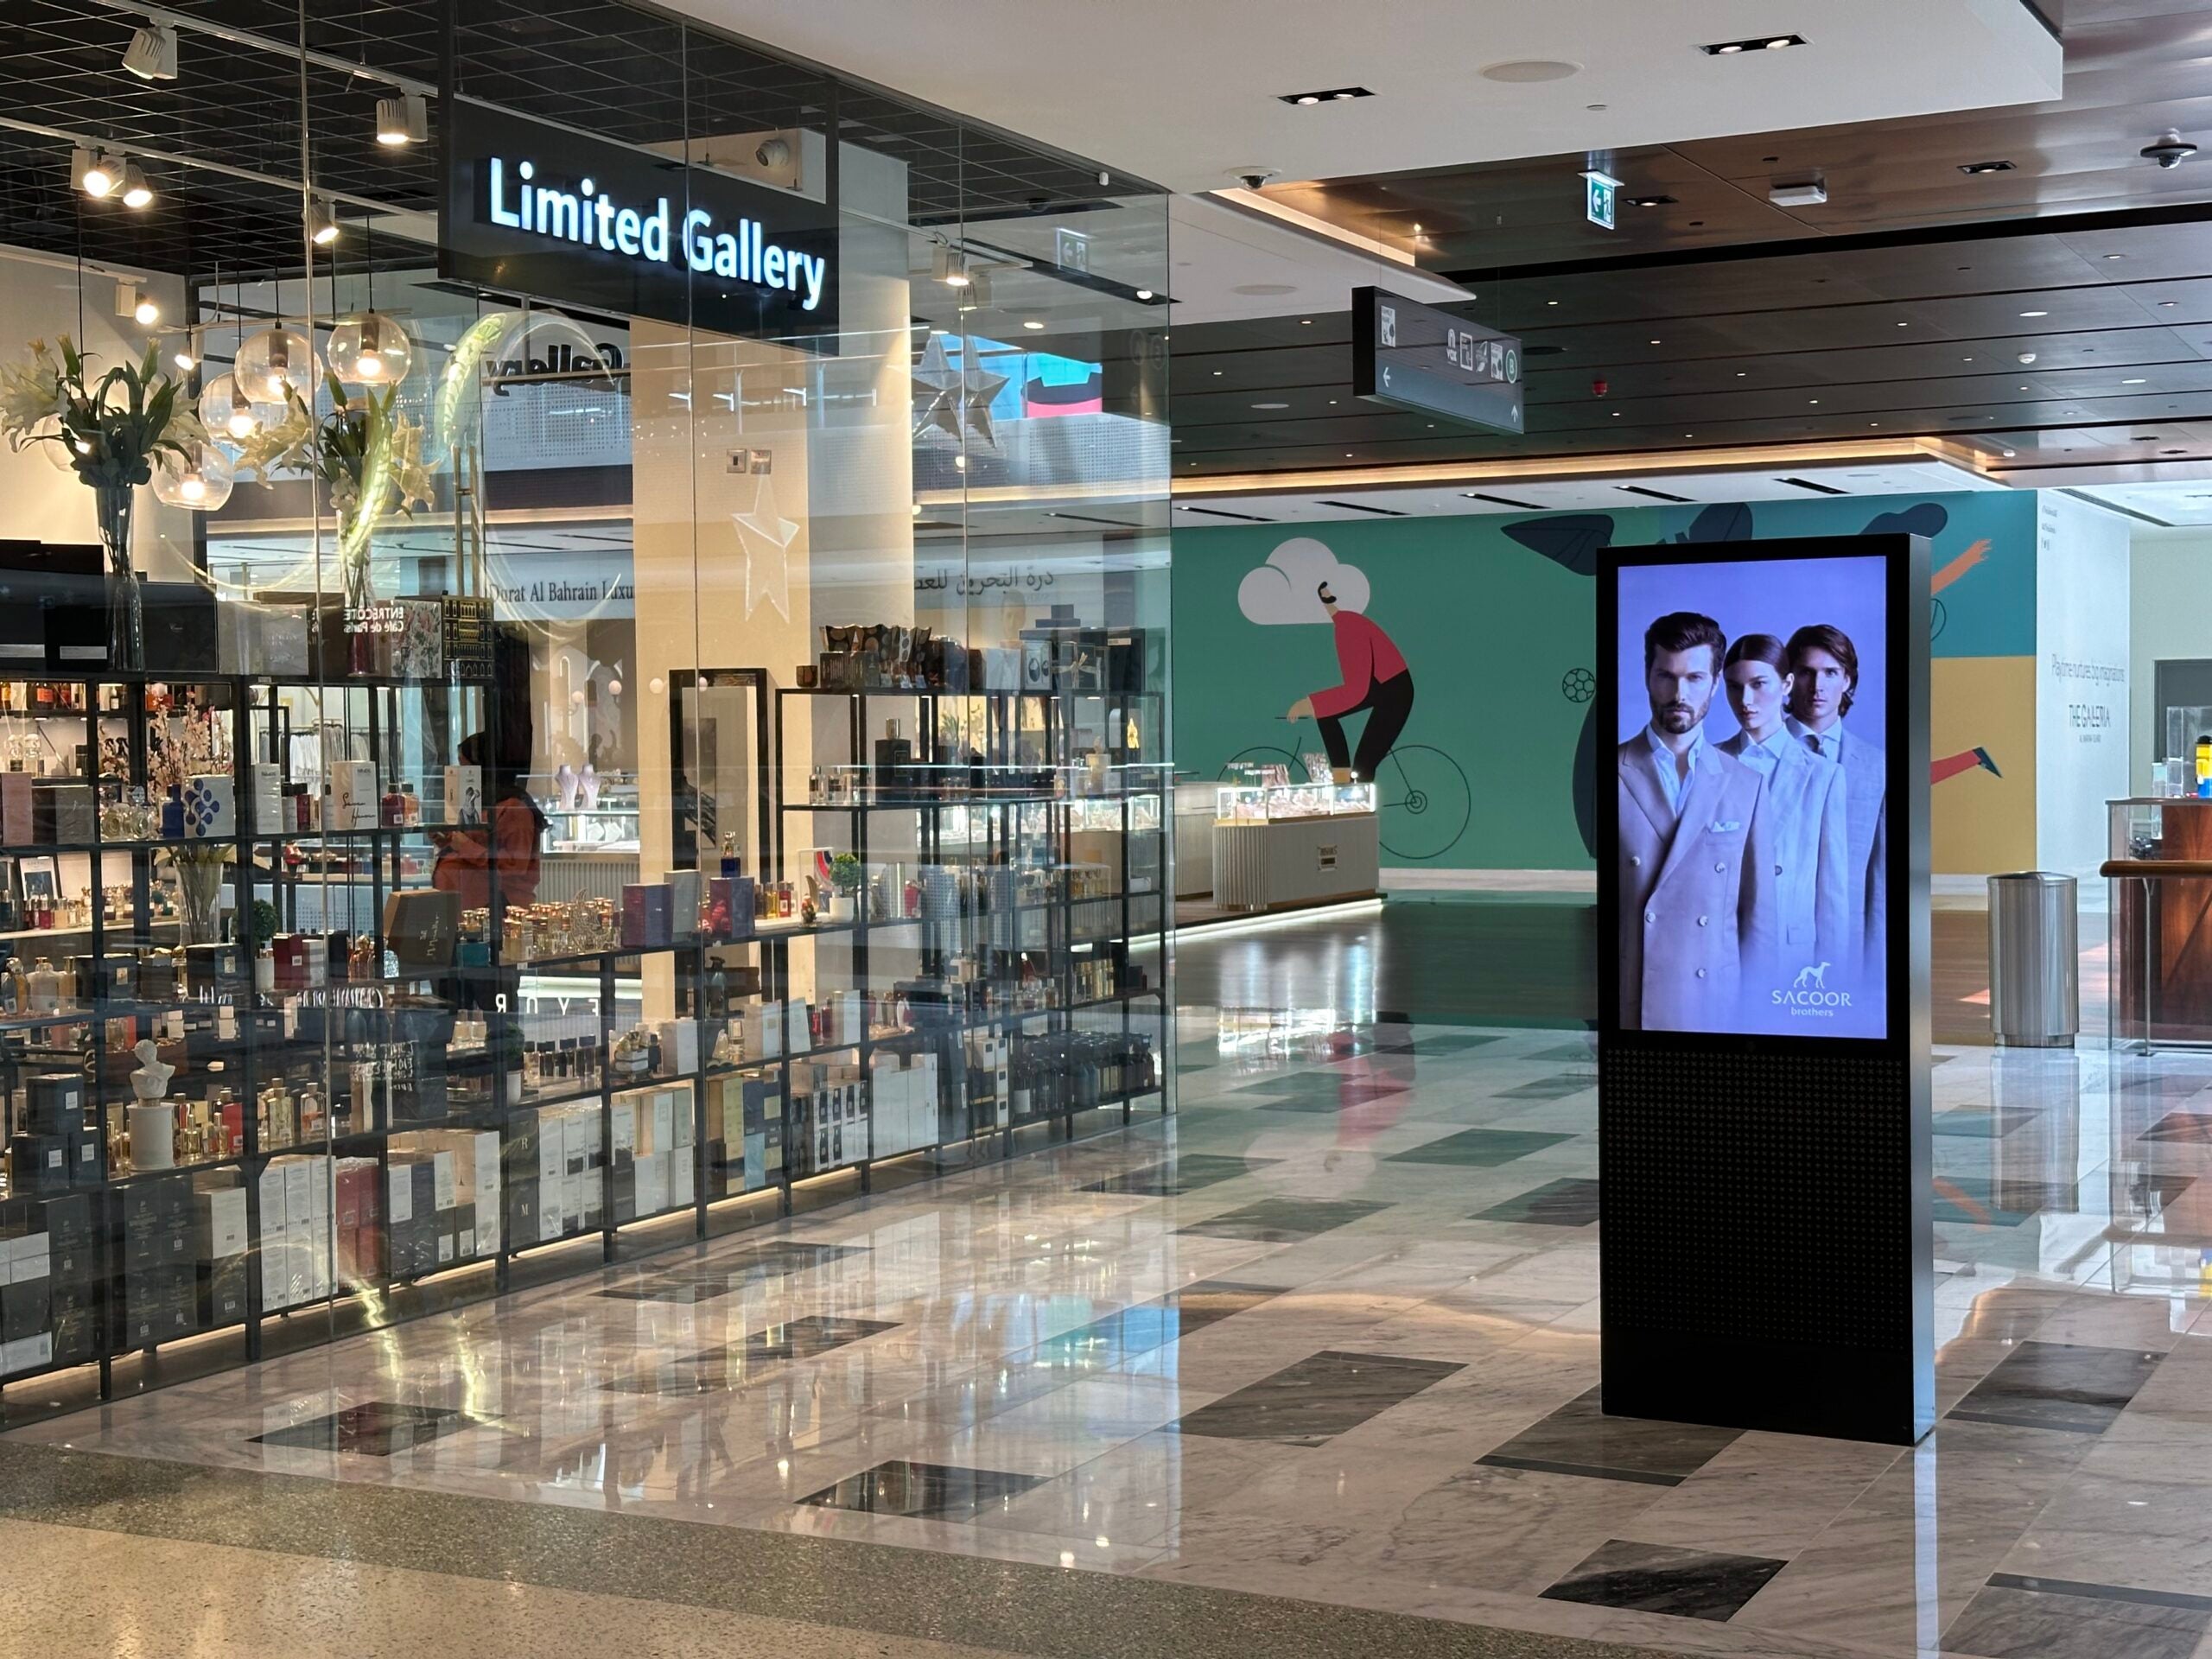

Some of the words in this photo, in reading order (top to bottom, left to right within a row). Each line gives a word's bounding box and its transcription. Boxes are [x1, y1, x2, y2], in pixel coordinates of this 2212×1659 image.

[489, 158, 669, 263] Limited
[683, 209, 826, 311] Gallery
[530, 581, 544, 602] Al
[549, 582, 597, 602] Bahrain
[2069, 704, 2081, 728] THE
[1771, 989, 1853, 1007] SACOOR
[1790, 1007, 1834, 1017] brothers
[521, 1137, 529, 1150] R
[521, 1203, 529, 1217] M
